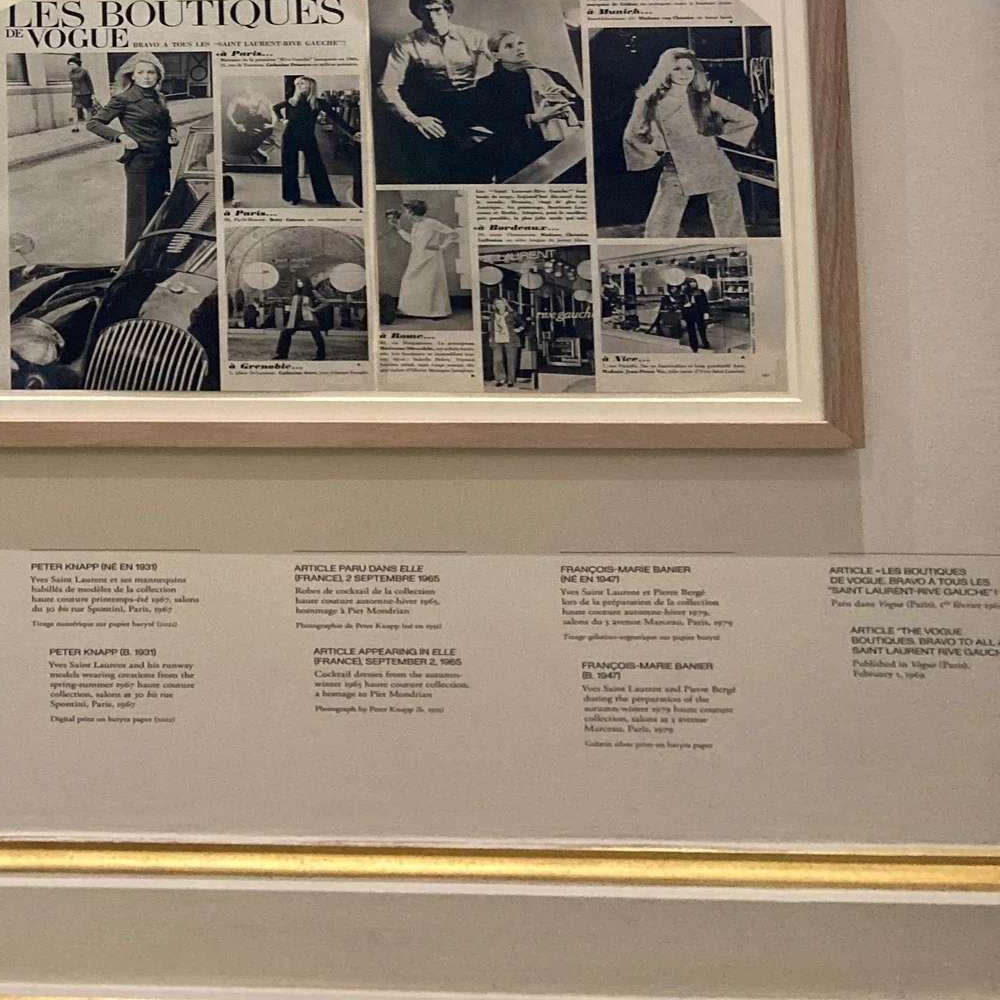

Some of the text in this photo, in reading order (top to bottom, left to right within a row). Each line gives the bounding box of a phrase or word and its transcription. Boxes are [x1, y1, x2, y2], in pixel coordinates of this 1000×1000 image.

[6, 0, 84, 28] LES
[6, 28, 128, 48] DE VOGUE
[136, 563, 157, 571] 1931)
[561, 566, 650, 575] FRANÇOIS-MARIE
[904, 568, 966, 576] BOUTIQUES
[30, 576, 48, 586] Yves
[51, 576, 72, 586] Saint
[75, 576, 107, 586] Laurent
[135, 577, 186, 586] mannequins
[314, 648, 355, 656] ARTICLE
[358, 648, 416, 656] APPEARING
[432, 648, 455, 656] ELLE
[582, 662, 672, 672] FRANÇOIS-MARIE
